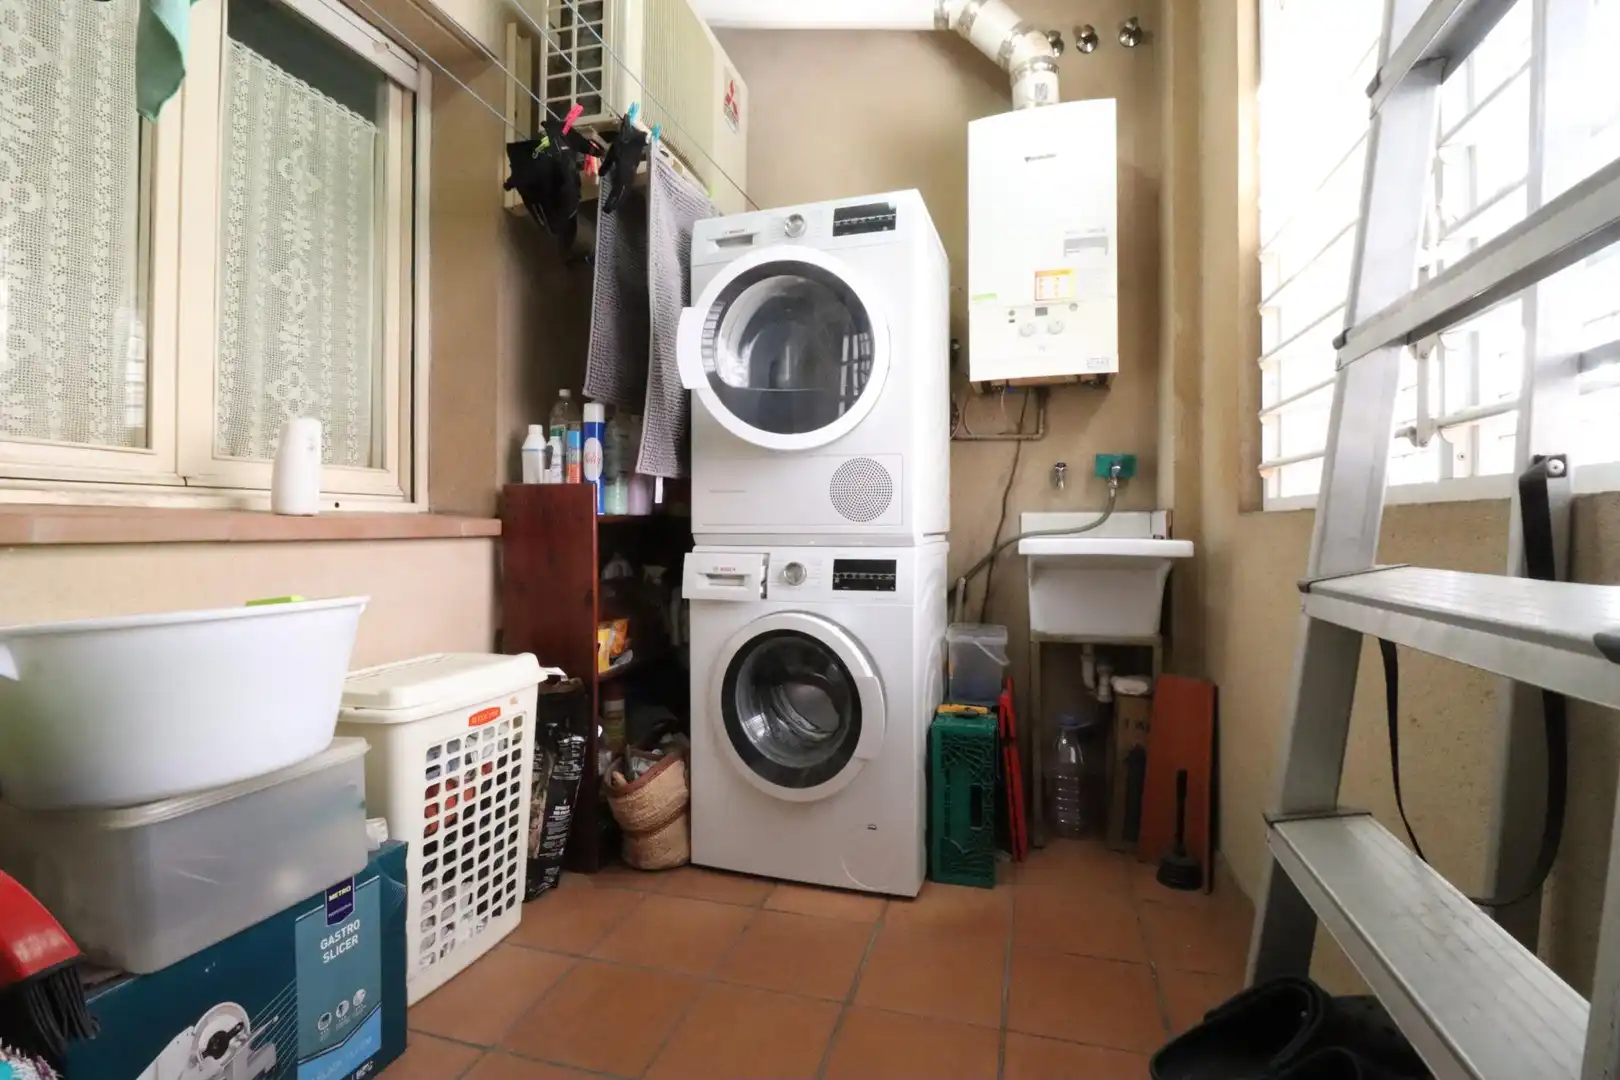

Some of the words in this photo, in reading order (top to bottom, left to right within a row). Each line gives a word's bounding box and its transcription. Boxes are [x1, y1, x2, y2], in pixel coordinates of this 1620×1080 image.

[328, 885, 352, 902] METRO
[320, 919, 360, 950] GASTRO
[322, 934, 359, 964] SLICER
